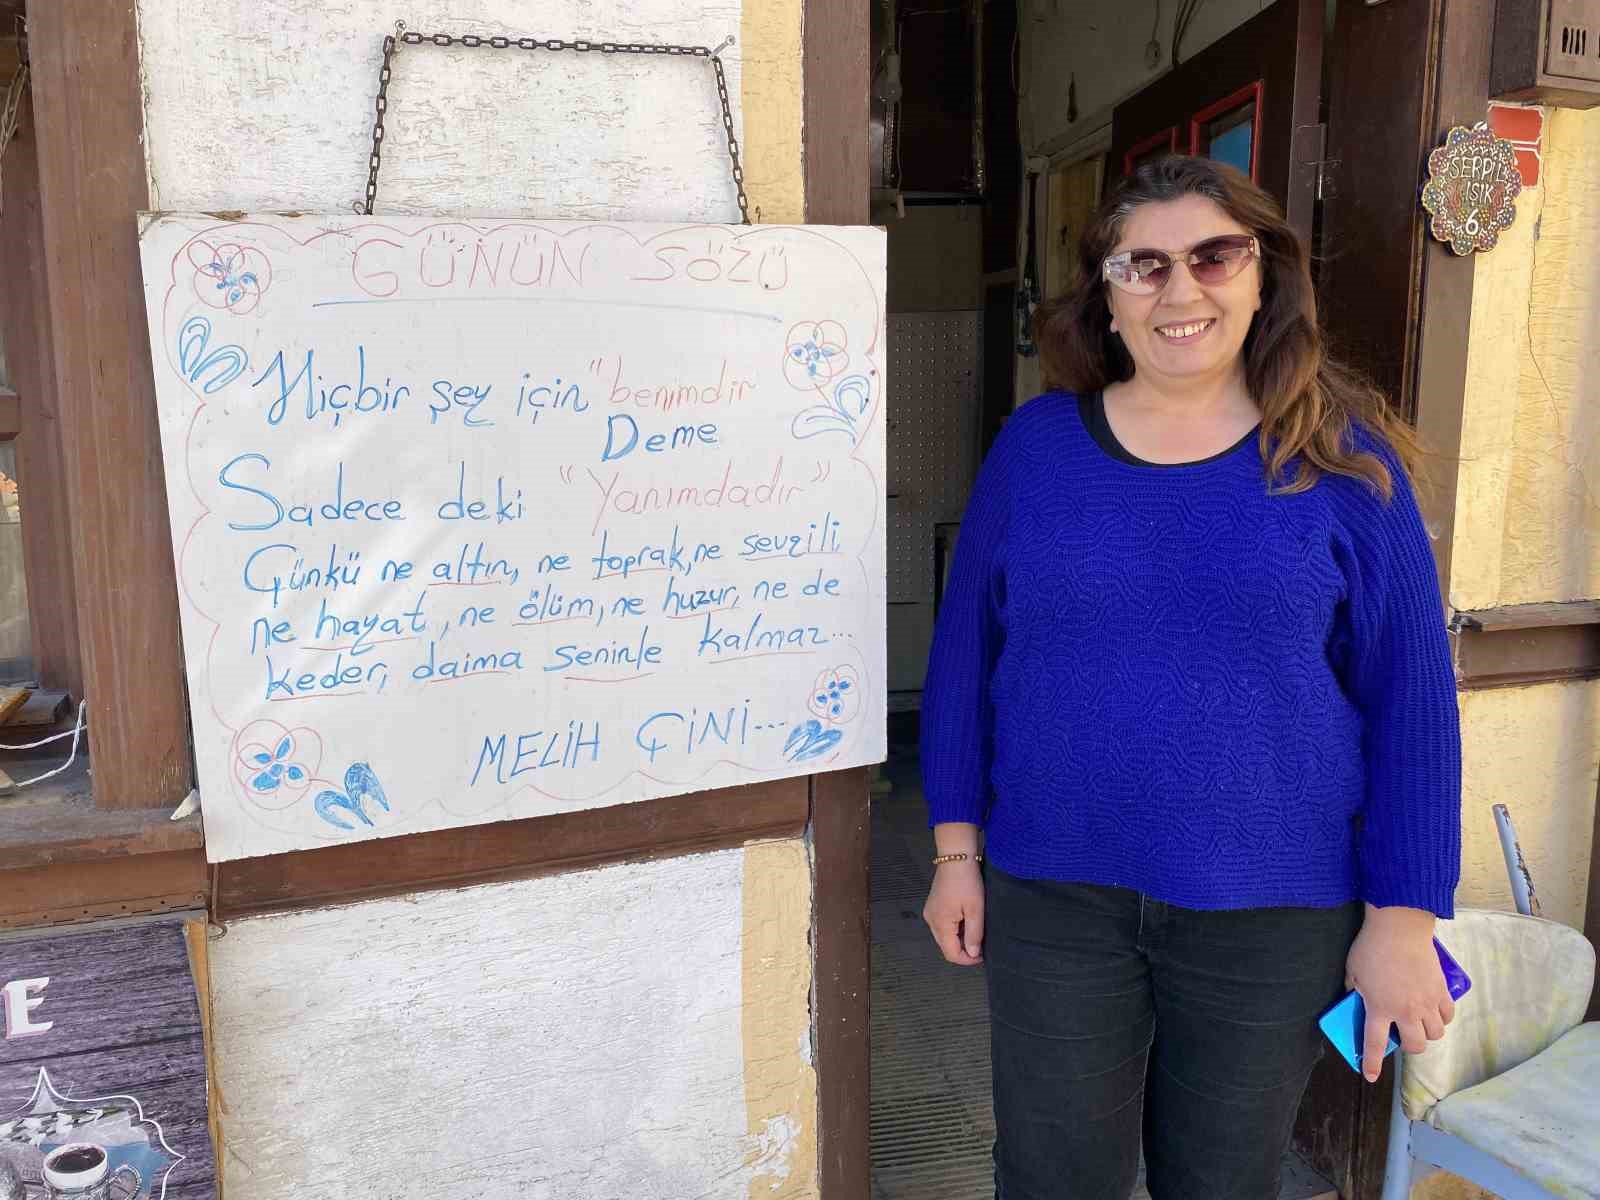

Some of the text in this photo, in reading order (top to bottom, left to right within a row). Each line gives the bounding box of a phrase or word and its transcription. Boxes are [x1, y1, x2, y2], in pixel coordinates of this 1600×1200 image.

[1465, 208, 1479, 235] 6
[352, 231, 788, 296] GÜNÜN SÖZÜ
[252, 345, 411, 426] Hiçbir
[429, 380, 496, 426] şey
[516, 372, 590, 424] için
[602, 413, 718, 461] Deme
[219, 453, 406, 530] Sadece
[244, 543, 360, 607] Çünkü
[381, 560, 414, 583] ne
[538, 558, 570, 573] ne
[251, 617, 296, 656] ne
[460, 605, 496, 626] ne
[611, 597, 646, 615] ne
[753, 580, 789, 600] ne
[802, 568, 840, 596] de
[412, 641, 524, 682] daima
